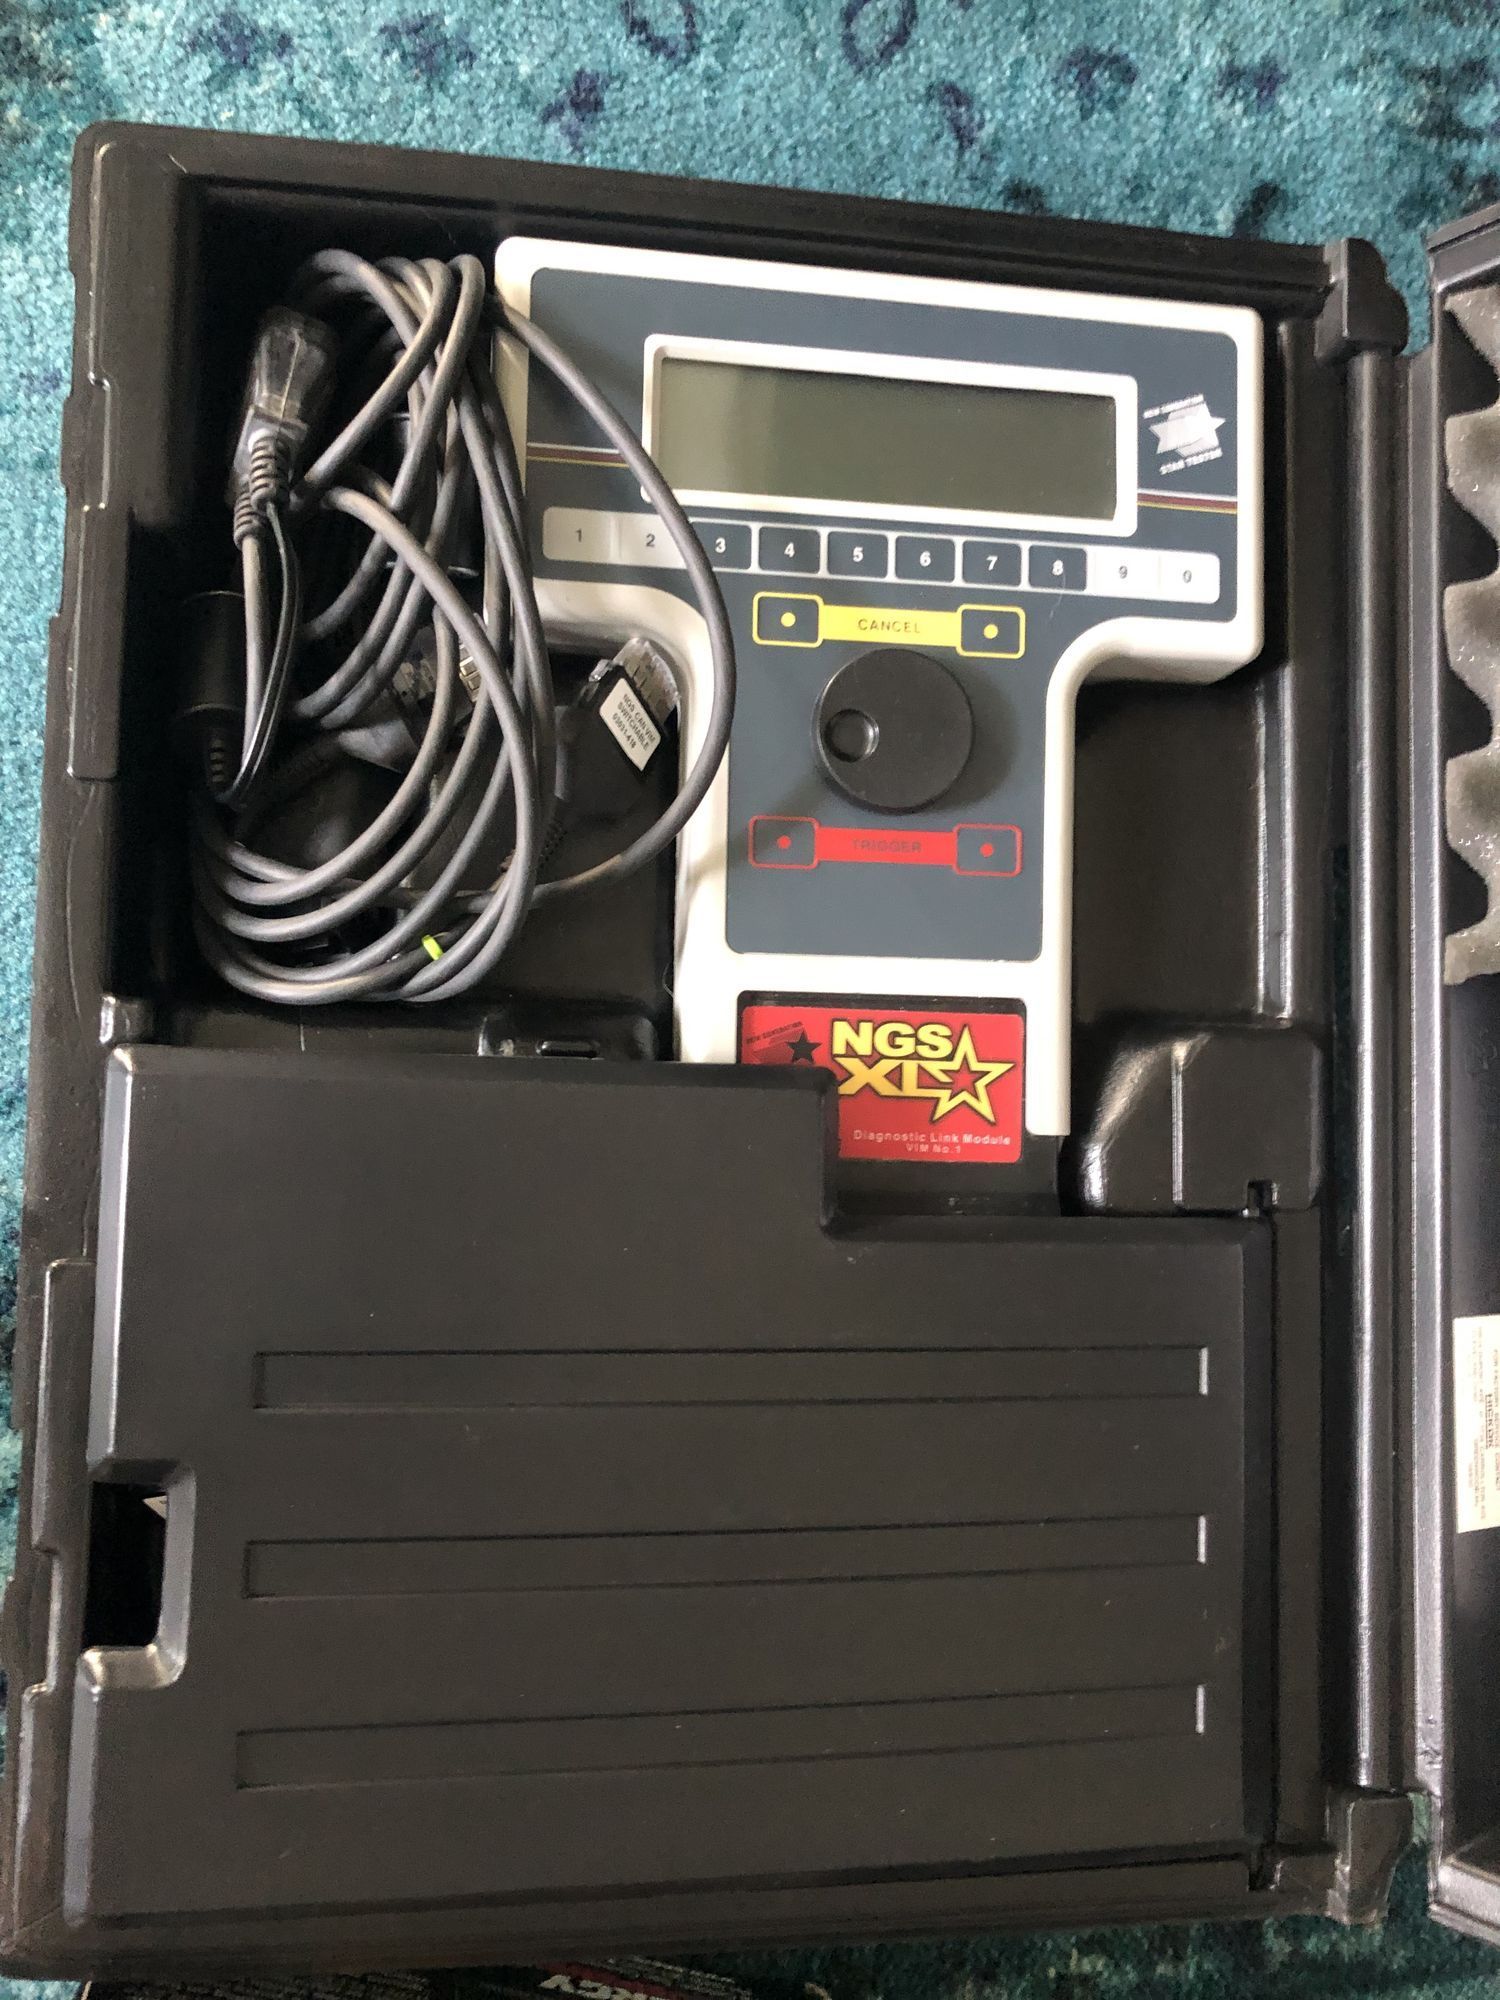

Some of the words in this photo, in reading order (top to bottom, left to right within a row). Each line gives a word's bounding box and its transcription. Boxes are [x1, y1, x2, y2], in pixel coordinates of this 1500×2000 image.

[575, 529, 583, 542] 1
[645, 534, 656, 548] 2
[714, 537, 727, 553] 3
[783, 542, 796, 558] 4
[852, 547, 865, 563] 5
[919, 550, 932, 567] 6
[986, 555, 998, 571] 7
[1052, 559, 1064, 576] 8
[1119, 565, 1128, 579] 9
[1182, 569, 1192, 583] 0
[857, 618, 921, 634] CANCEL
[852, 838, 922, 853] TRIGGER
[831, 1019, 954, 1059] NGS
[853, 1129, 926, 1143] Diagnostic
[930, 1132, 959, 1143] Link
[962, 1133, 1011, 1145] Module
